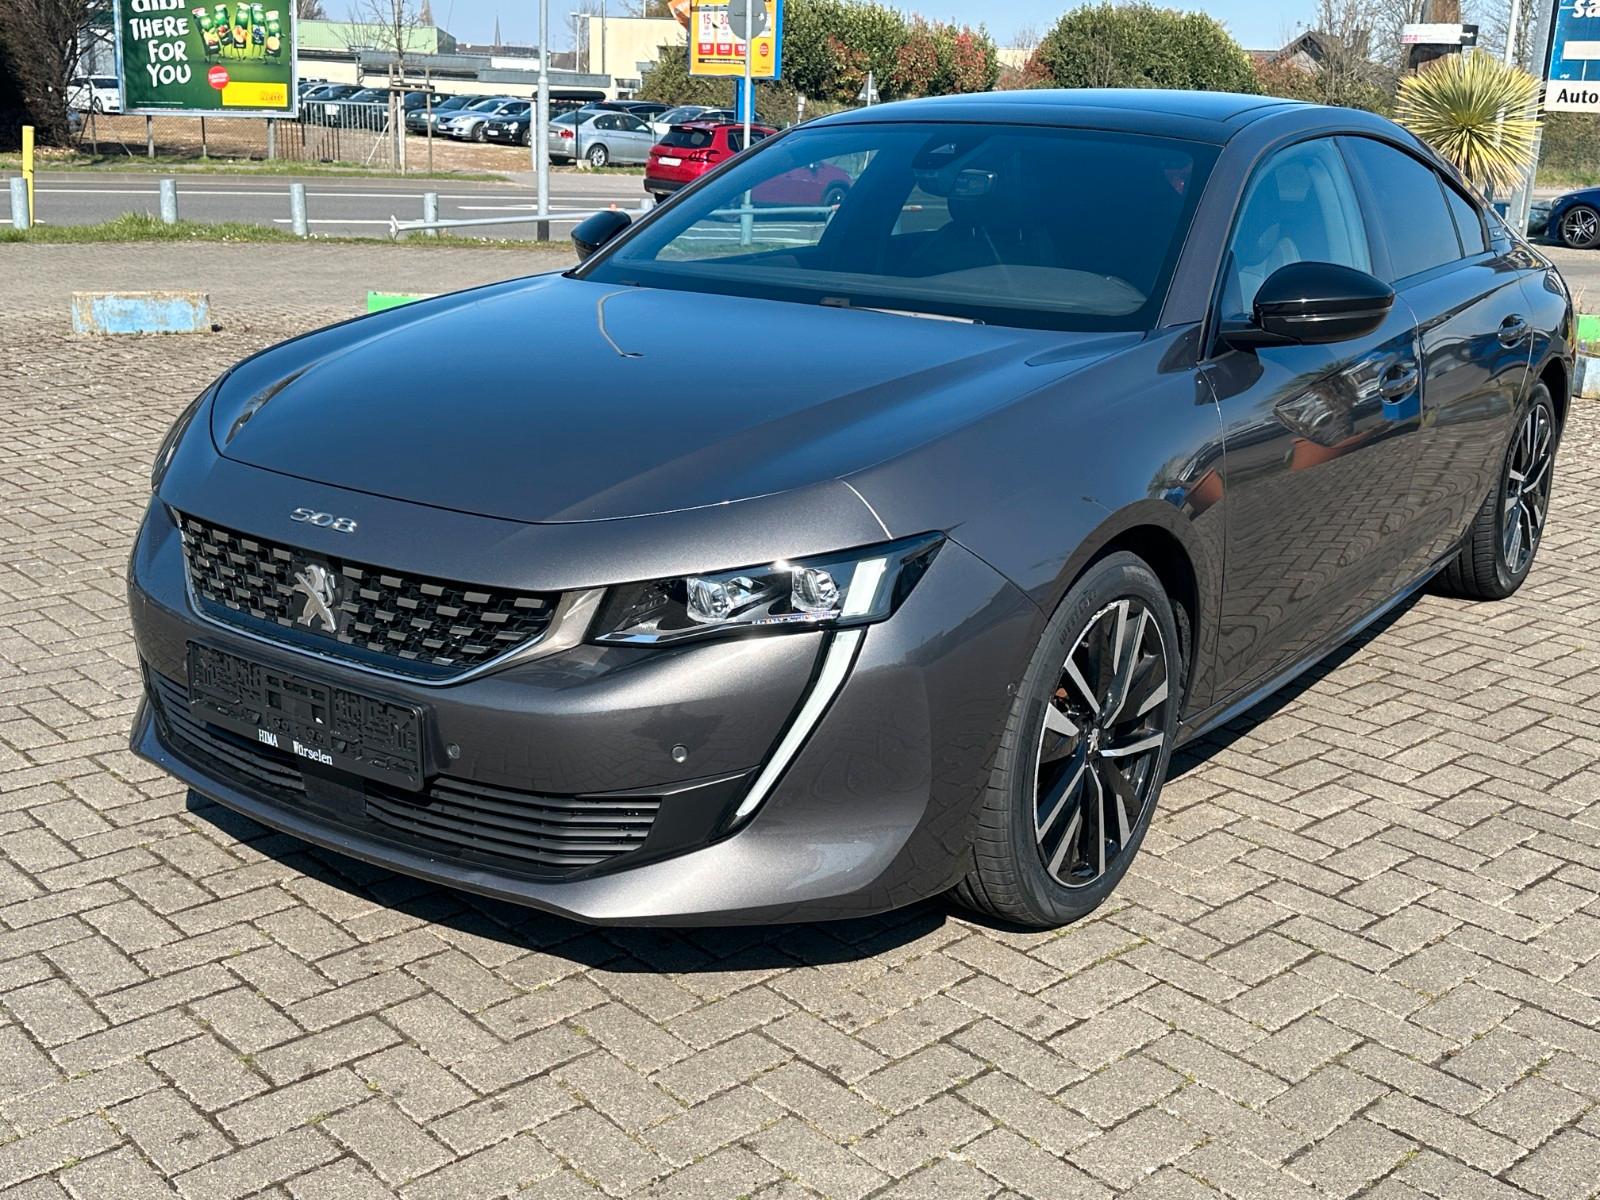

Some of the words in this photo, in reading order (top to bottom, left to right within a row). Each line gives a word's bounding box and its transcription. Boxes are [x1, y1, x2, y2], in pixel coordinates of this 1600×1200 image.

[129, 16, 190, 40] THERE
[703, 13, 711, 24] 15
[148, 40, 188, 63] FOR
[146, 63, 191, 87] YOU
[290, 507, 357, 534] 508
[258, 728, 279, 748] HIMA
[292, 740, 333, 766] Würselen
